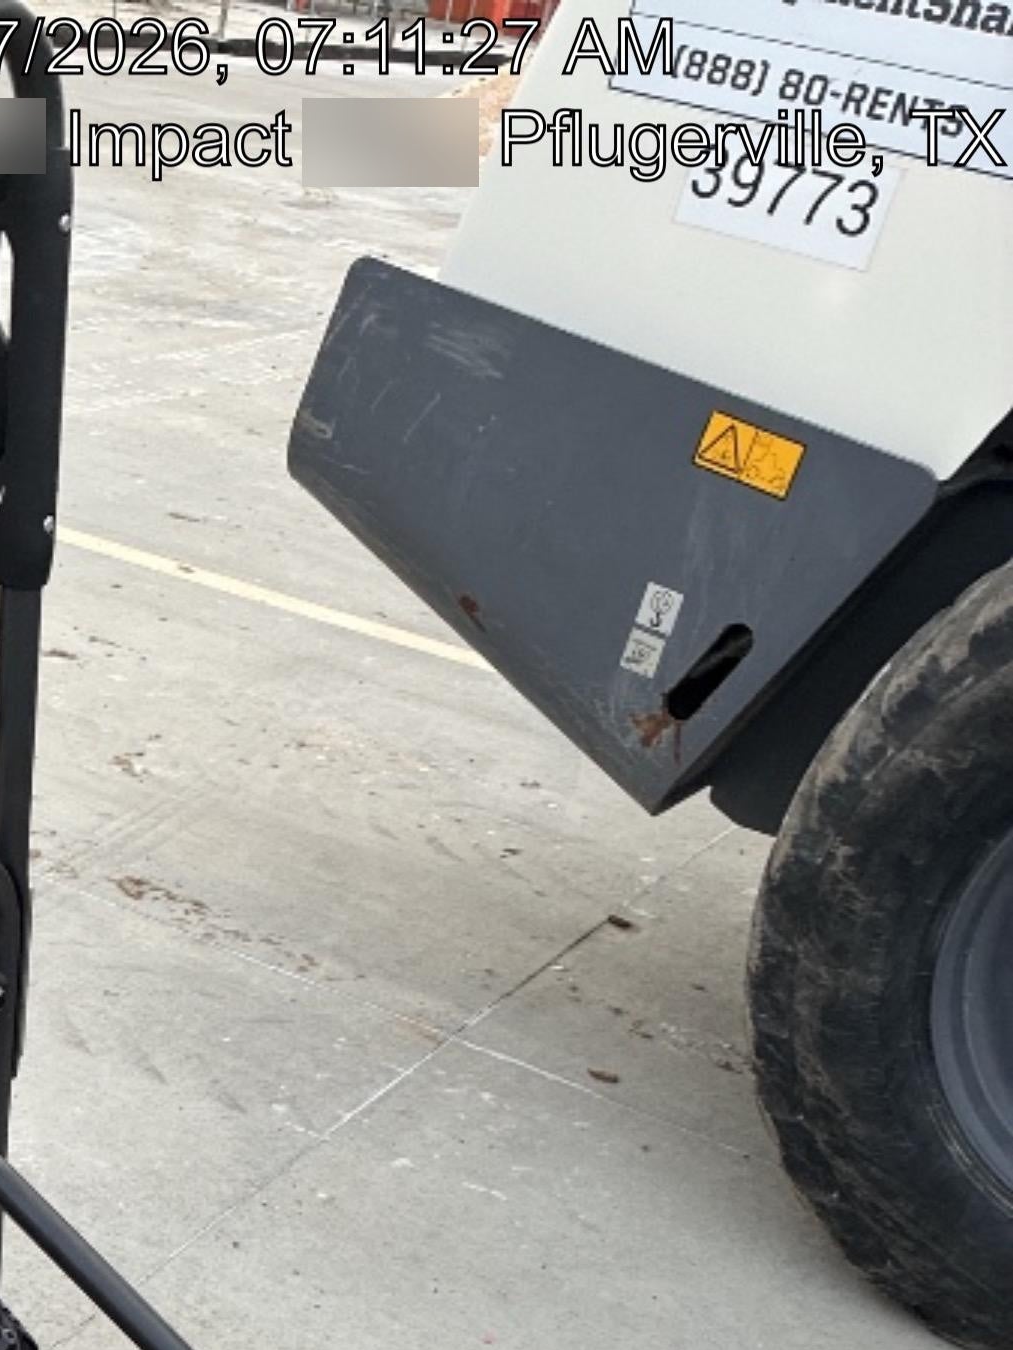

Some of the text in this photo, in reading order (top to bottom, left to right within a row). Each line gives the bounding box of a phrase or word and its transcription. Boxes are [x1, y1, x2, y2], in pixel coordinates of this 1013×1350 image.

[673, 45, 967, 137] (888) 80-RENTS
[691, 145, 880, 237] 39773
